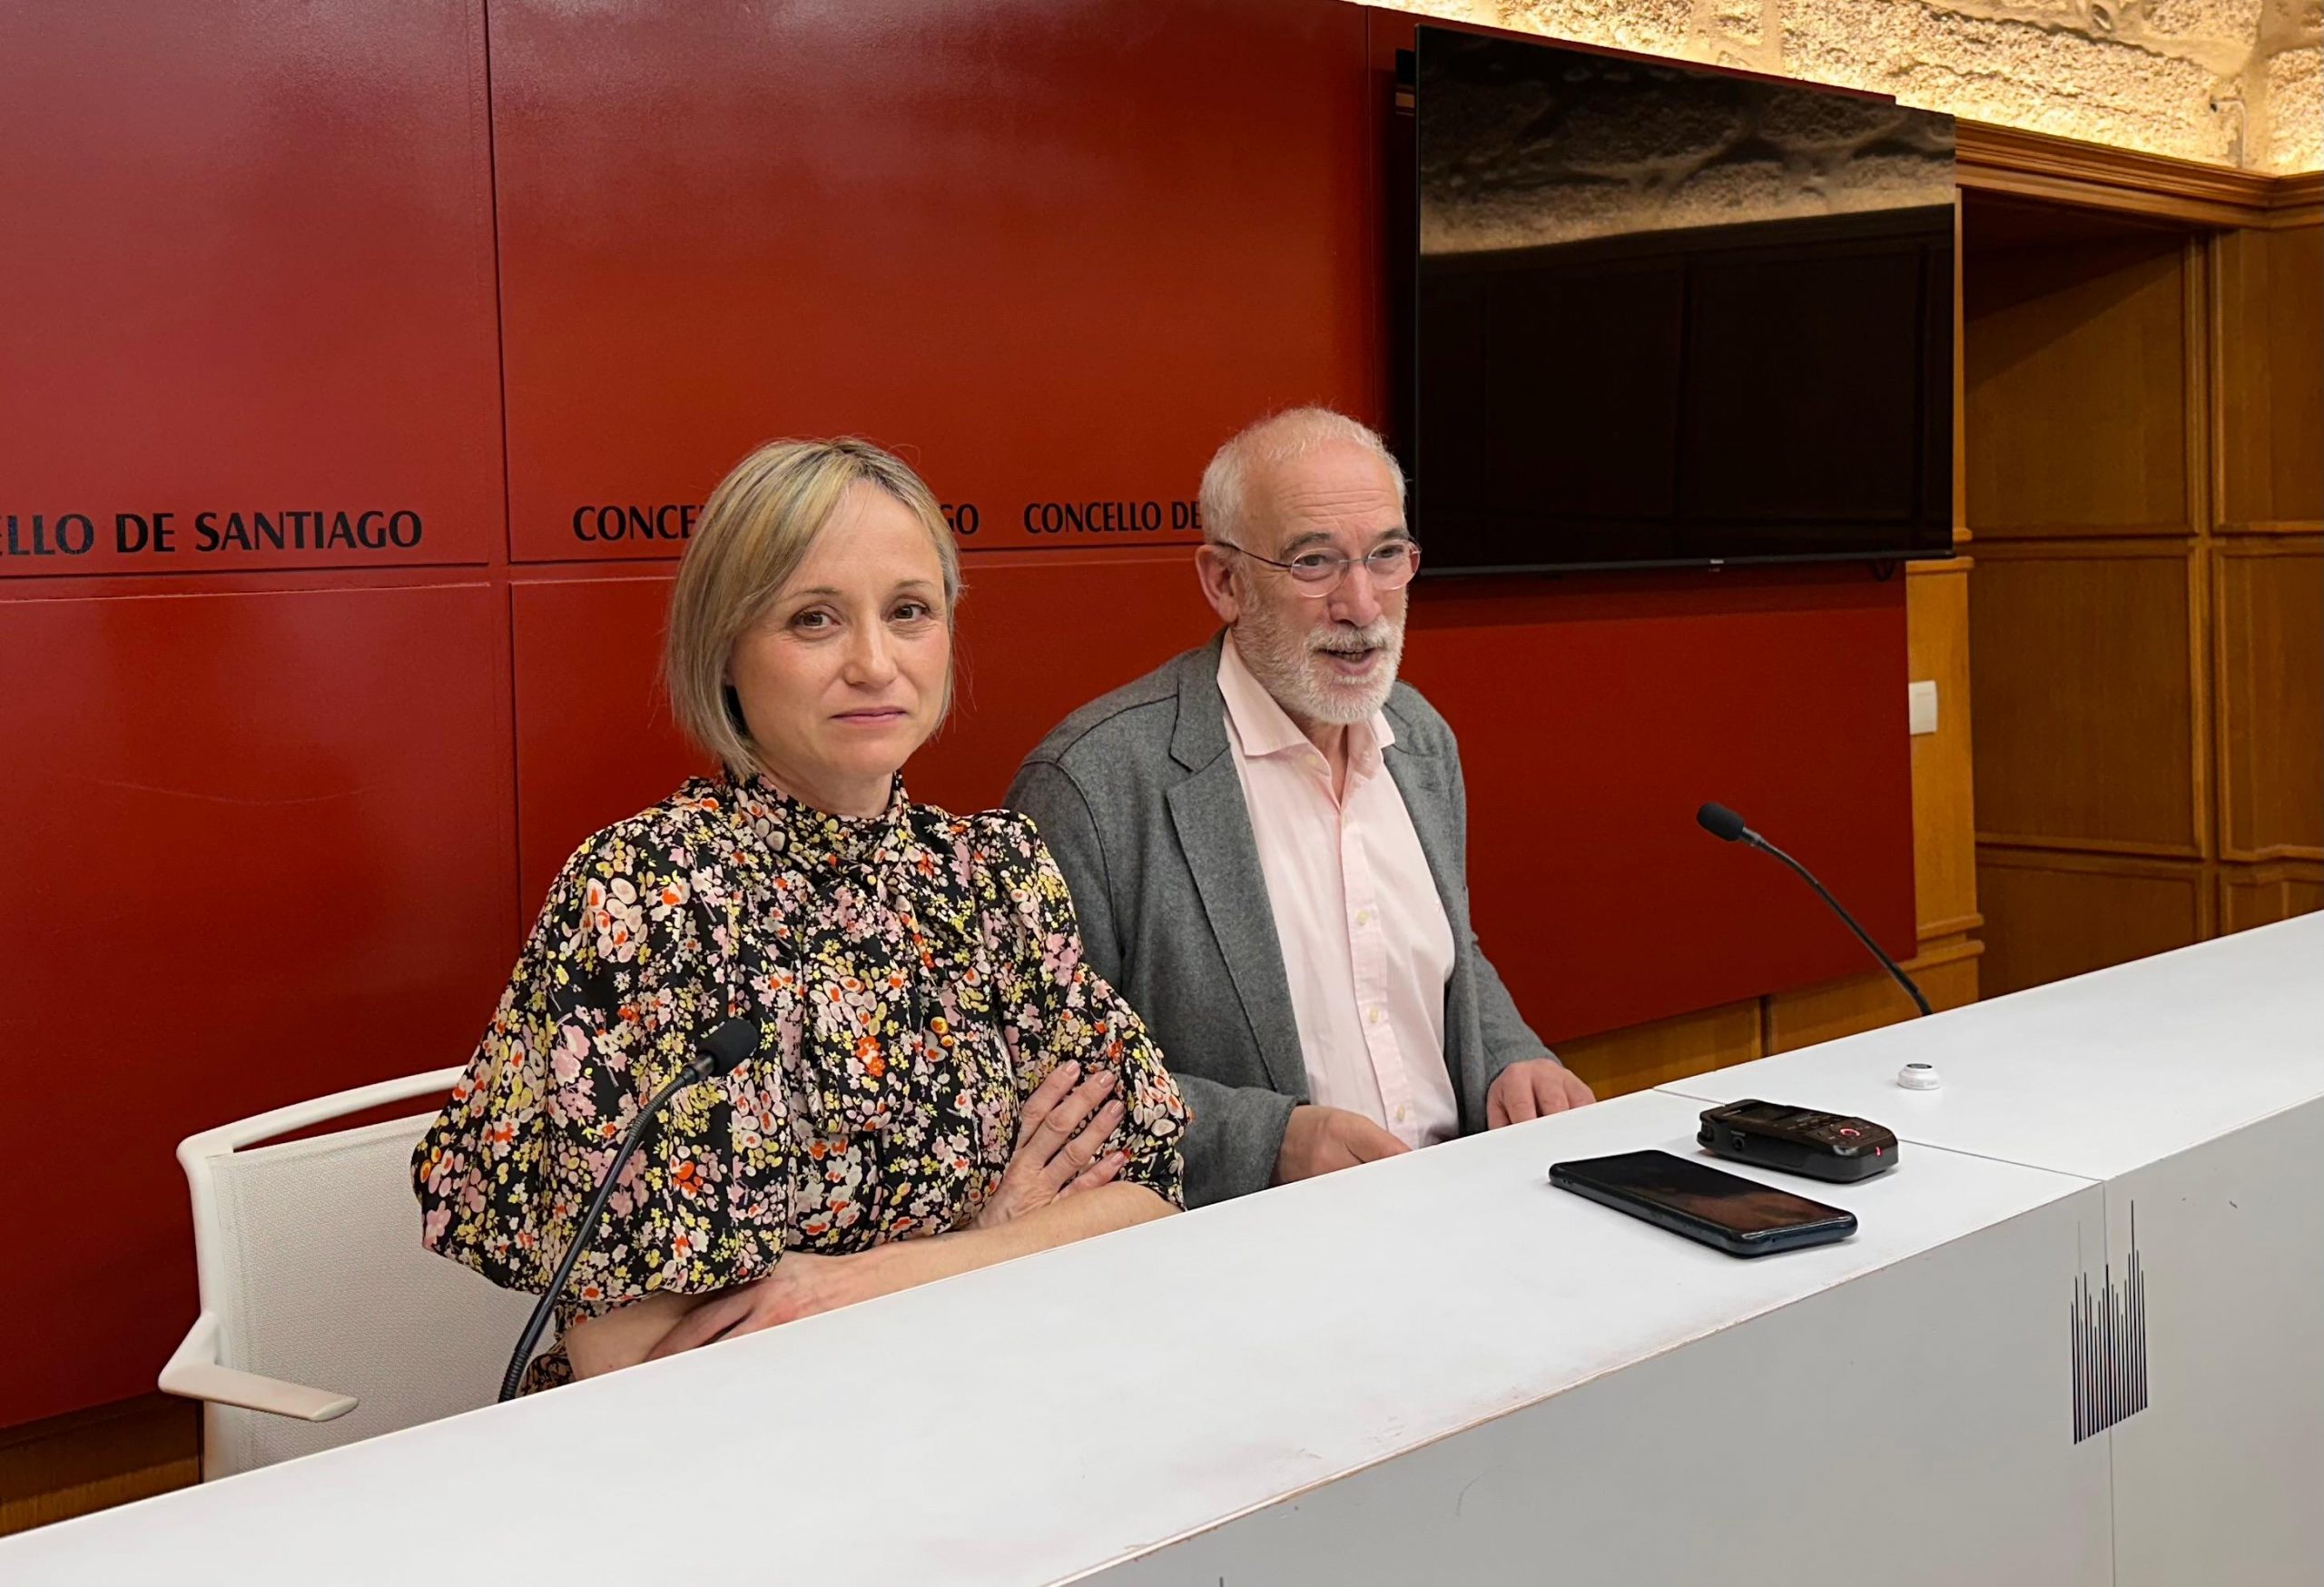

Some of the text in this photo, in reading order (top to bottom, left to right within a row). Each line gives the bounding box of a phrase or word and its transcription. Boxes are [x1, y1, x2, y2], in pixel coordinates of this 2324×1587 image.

[0, 510, 422, 555] LLO DE SANTIAGO
[573, 504, 704, 541] CONCE
[1023, 500, 1202, 534] CONCELLO DE
